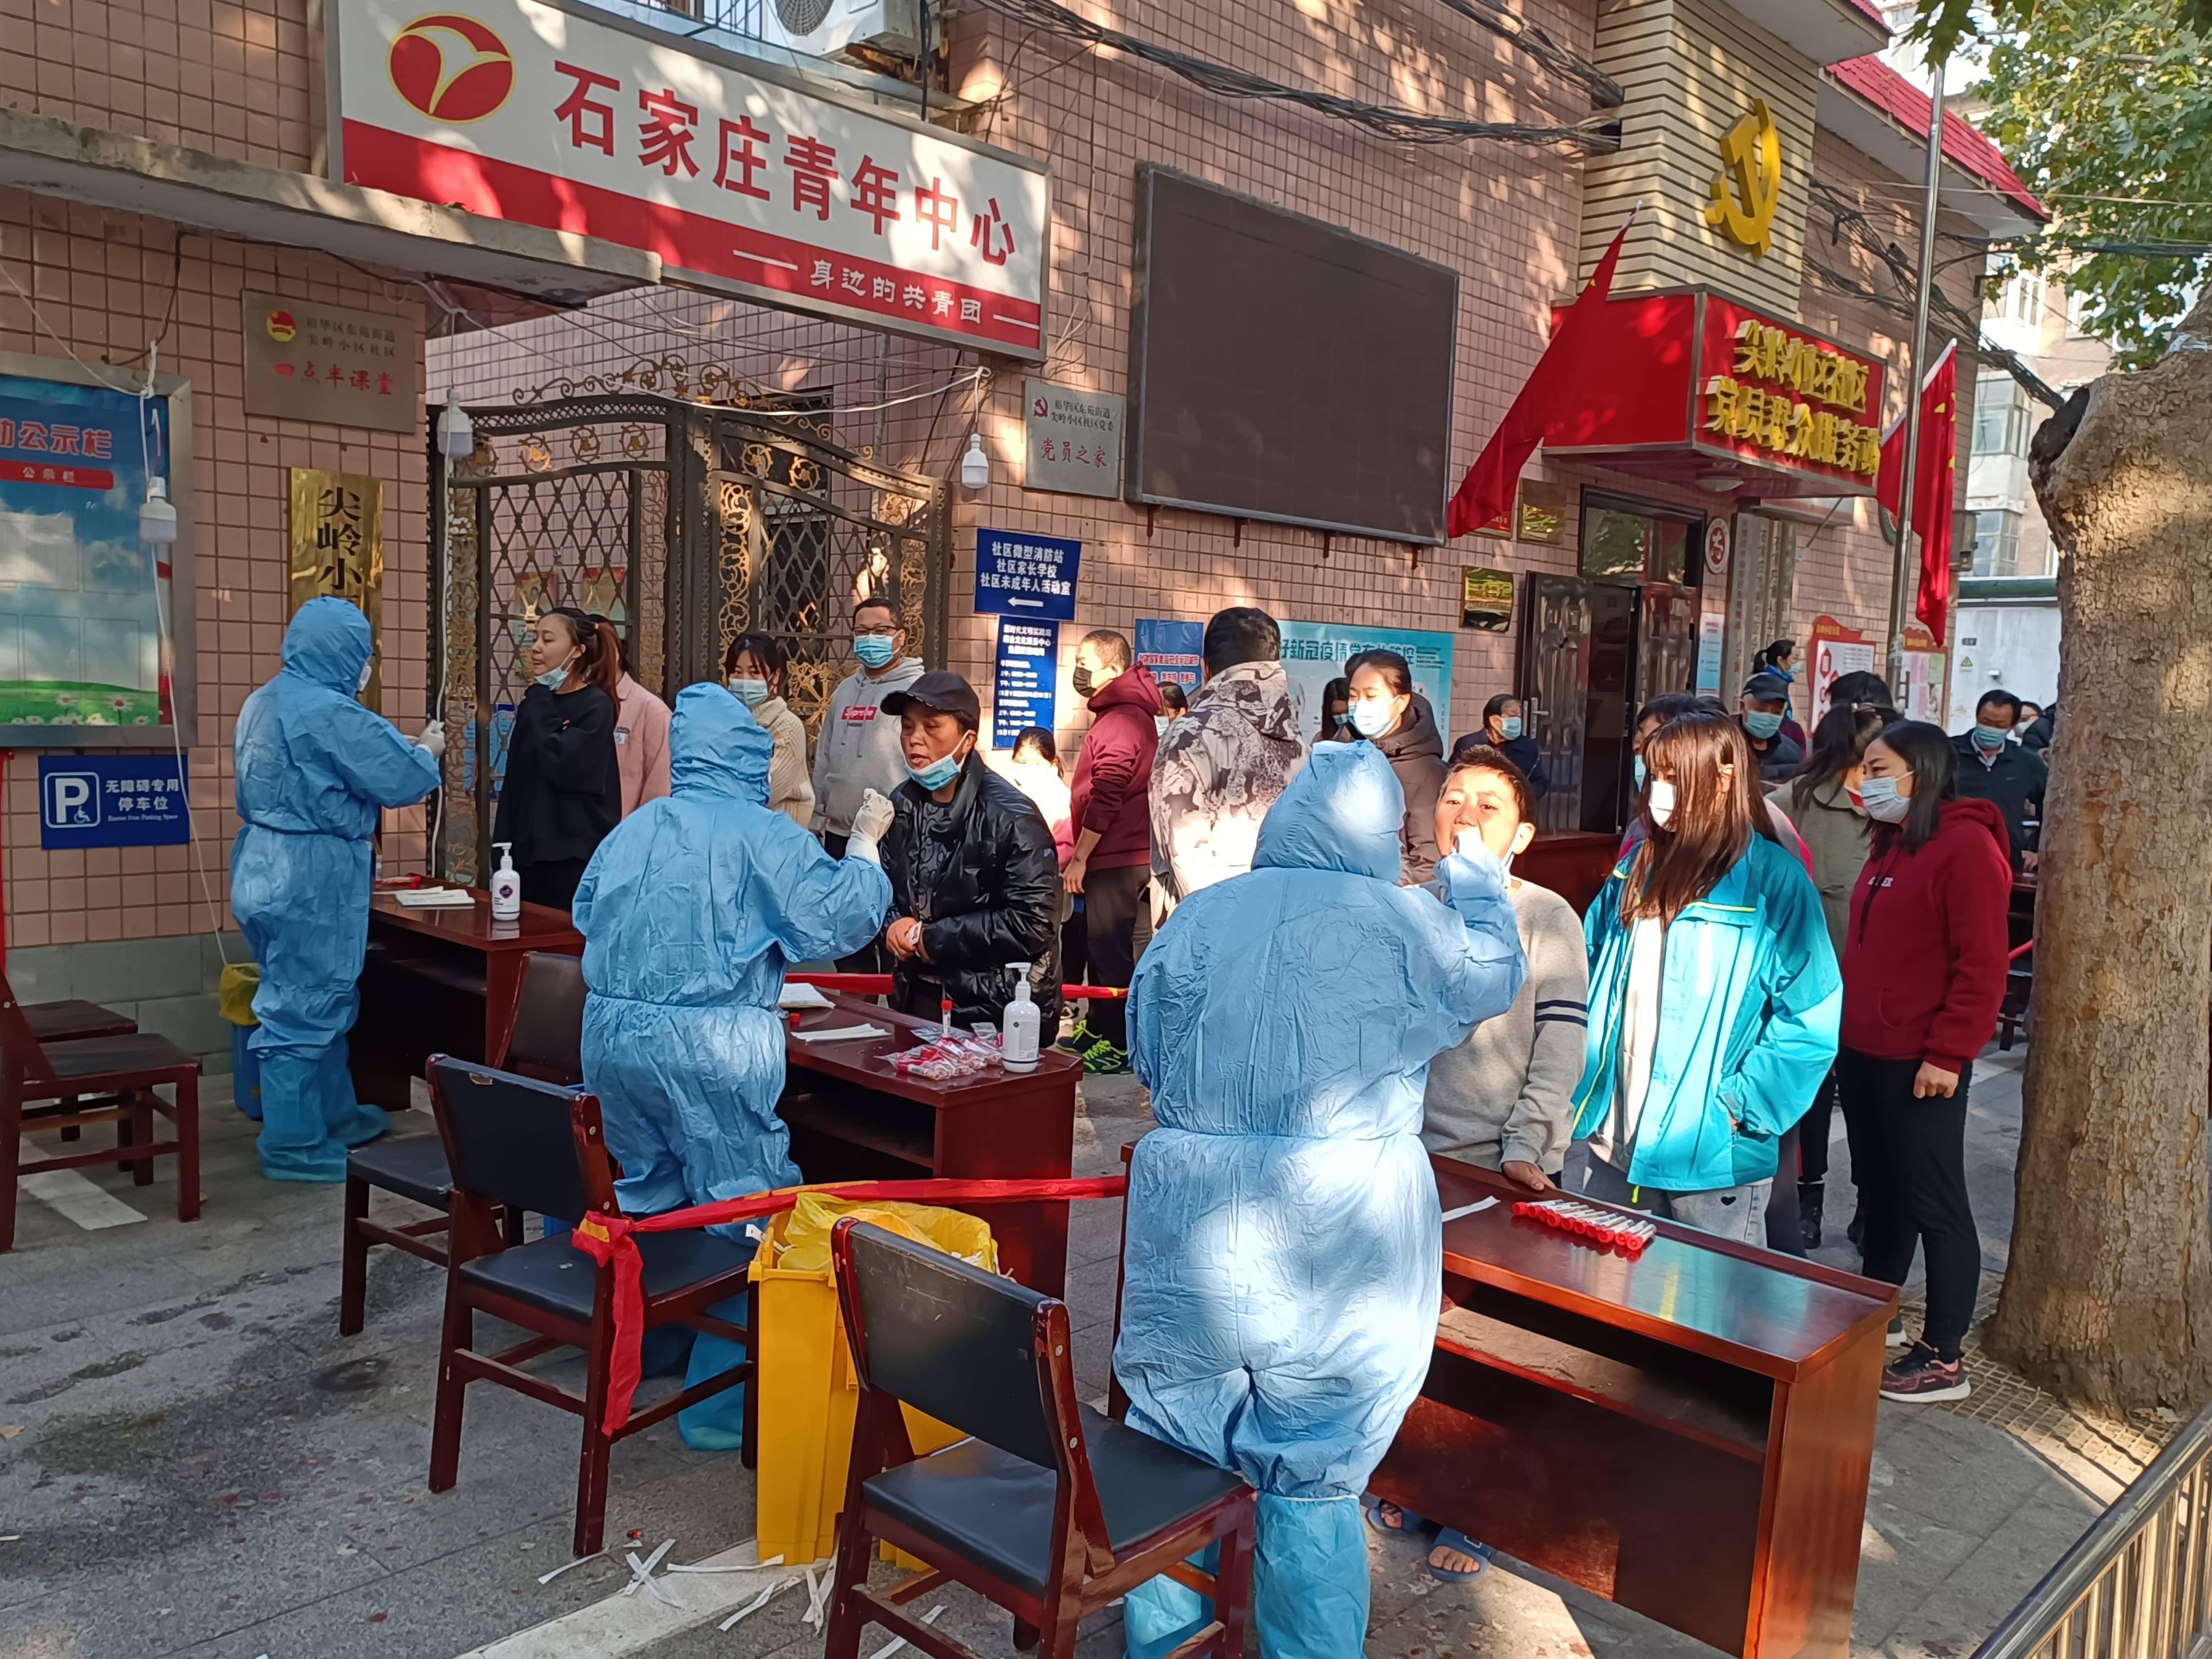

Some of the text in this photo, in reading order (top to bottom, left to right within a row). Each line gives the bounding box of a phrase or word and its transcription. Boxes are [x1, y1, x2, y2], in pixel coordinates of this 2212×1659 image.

[554, 60, 1015, 266] 石家庄青年中心
[810, 259, 982, 325] 身边的共青团
[273, 360, 393, 395] 一点半课堂
[1732, 319, 1870, 414] 尖岭小区社区
[1041, 437, 1107, 468] 党员之家
[316, 487, 363, 598] 尖岭小
[991, 541, 1064, 564] 社区微型消防站
[996, 558, 1058, 579] 社区家长学校
[980, 572, 1071, 595] 社区未成年人活动室
[1281, 639, 1415, 665] 好新冠疫情控
[844, 707, 874, 718] Spree
[105, 778, 179, 794] 无障碍专用
[55, 778, 89, 823] P
[118, 796, 169, 811] 停车位
